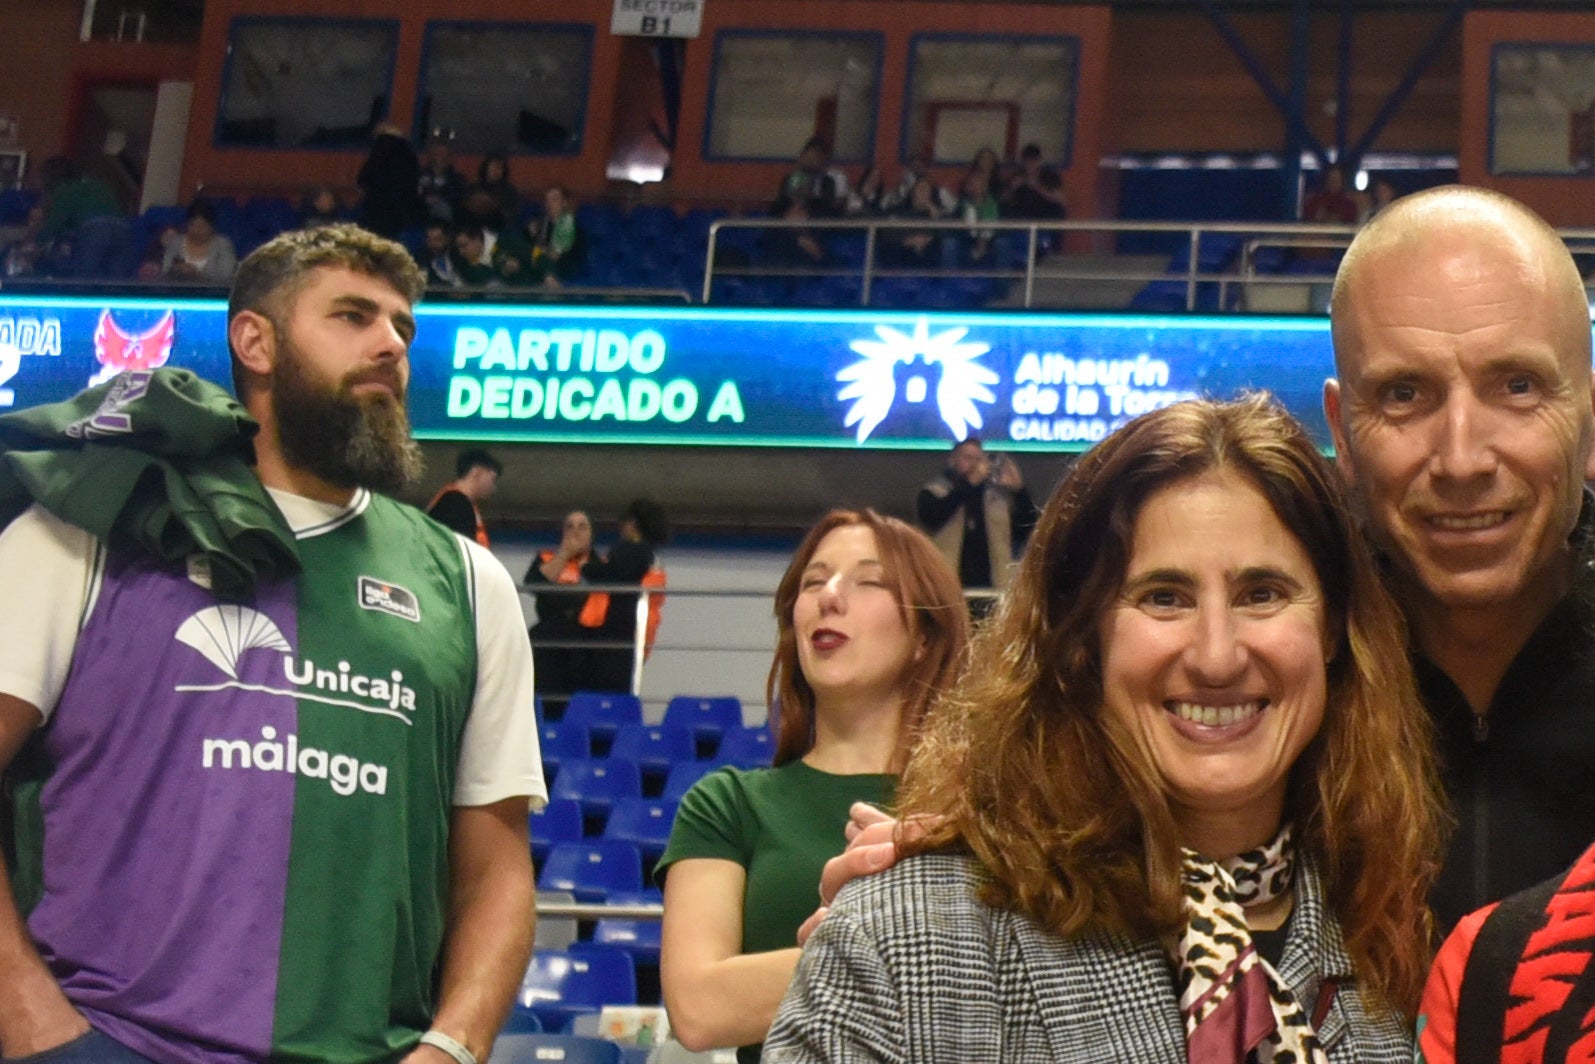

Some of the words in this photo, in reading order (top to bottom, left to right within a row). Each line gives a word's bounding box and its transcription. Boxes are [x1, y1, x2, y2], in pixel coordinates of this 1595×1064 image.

[641, 16, 671, 35] B1
[453, 327, 667, 374] PARTIDO
[447, 375, 699, 422] DEDICADO
[706, 379, 745, 423] A
[1011, 383, 1060, 416] de
[1065, 383, 1100, 416] la
[1009, 418, 1107, 441] CALIDAD
[284, 655, 417, 711] Unicaja
